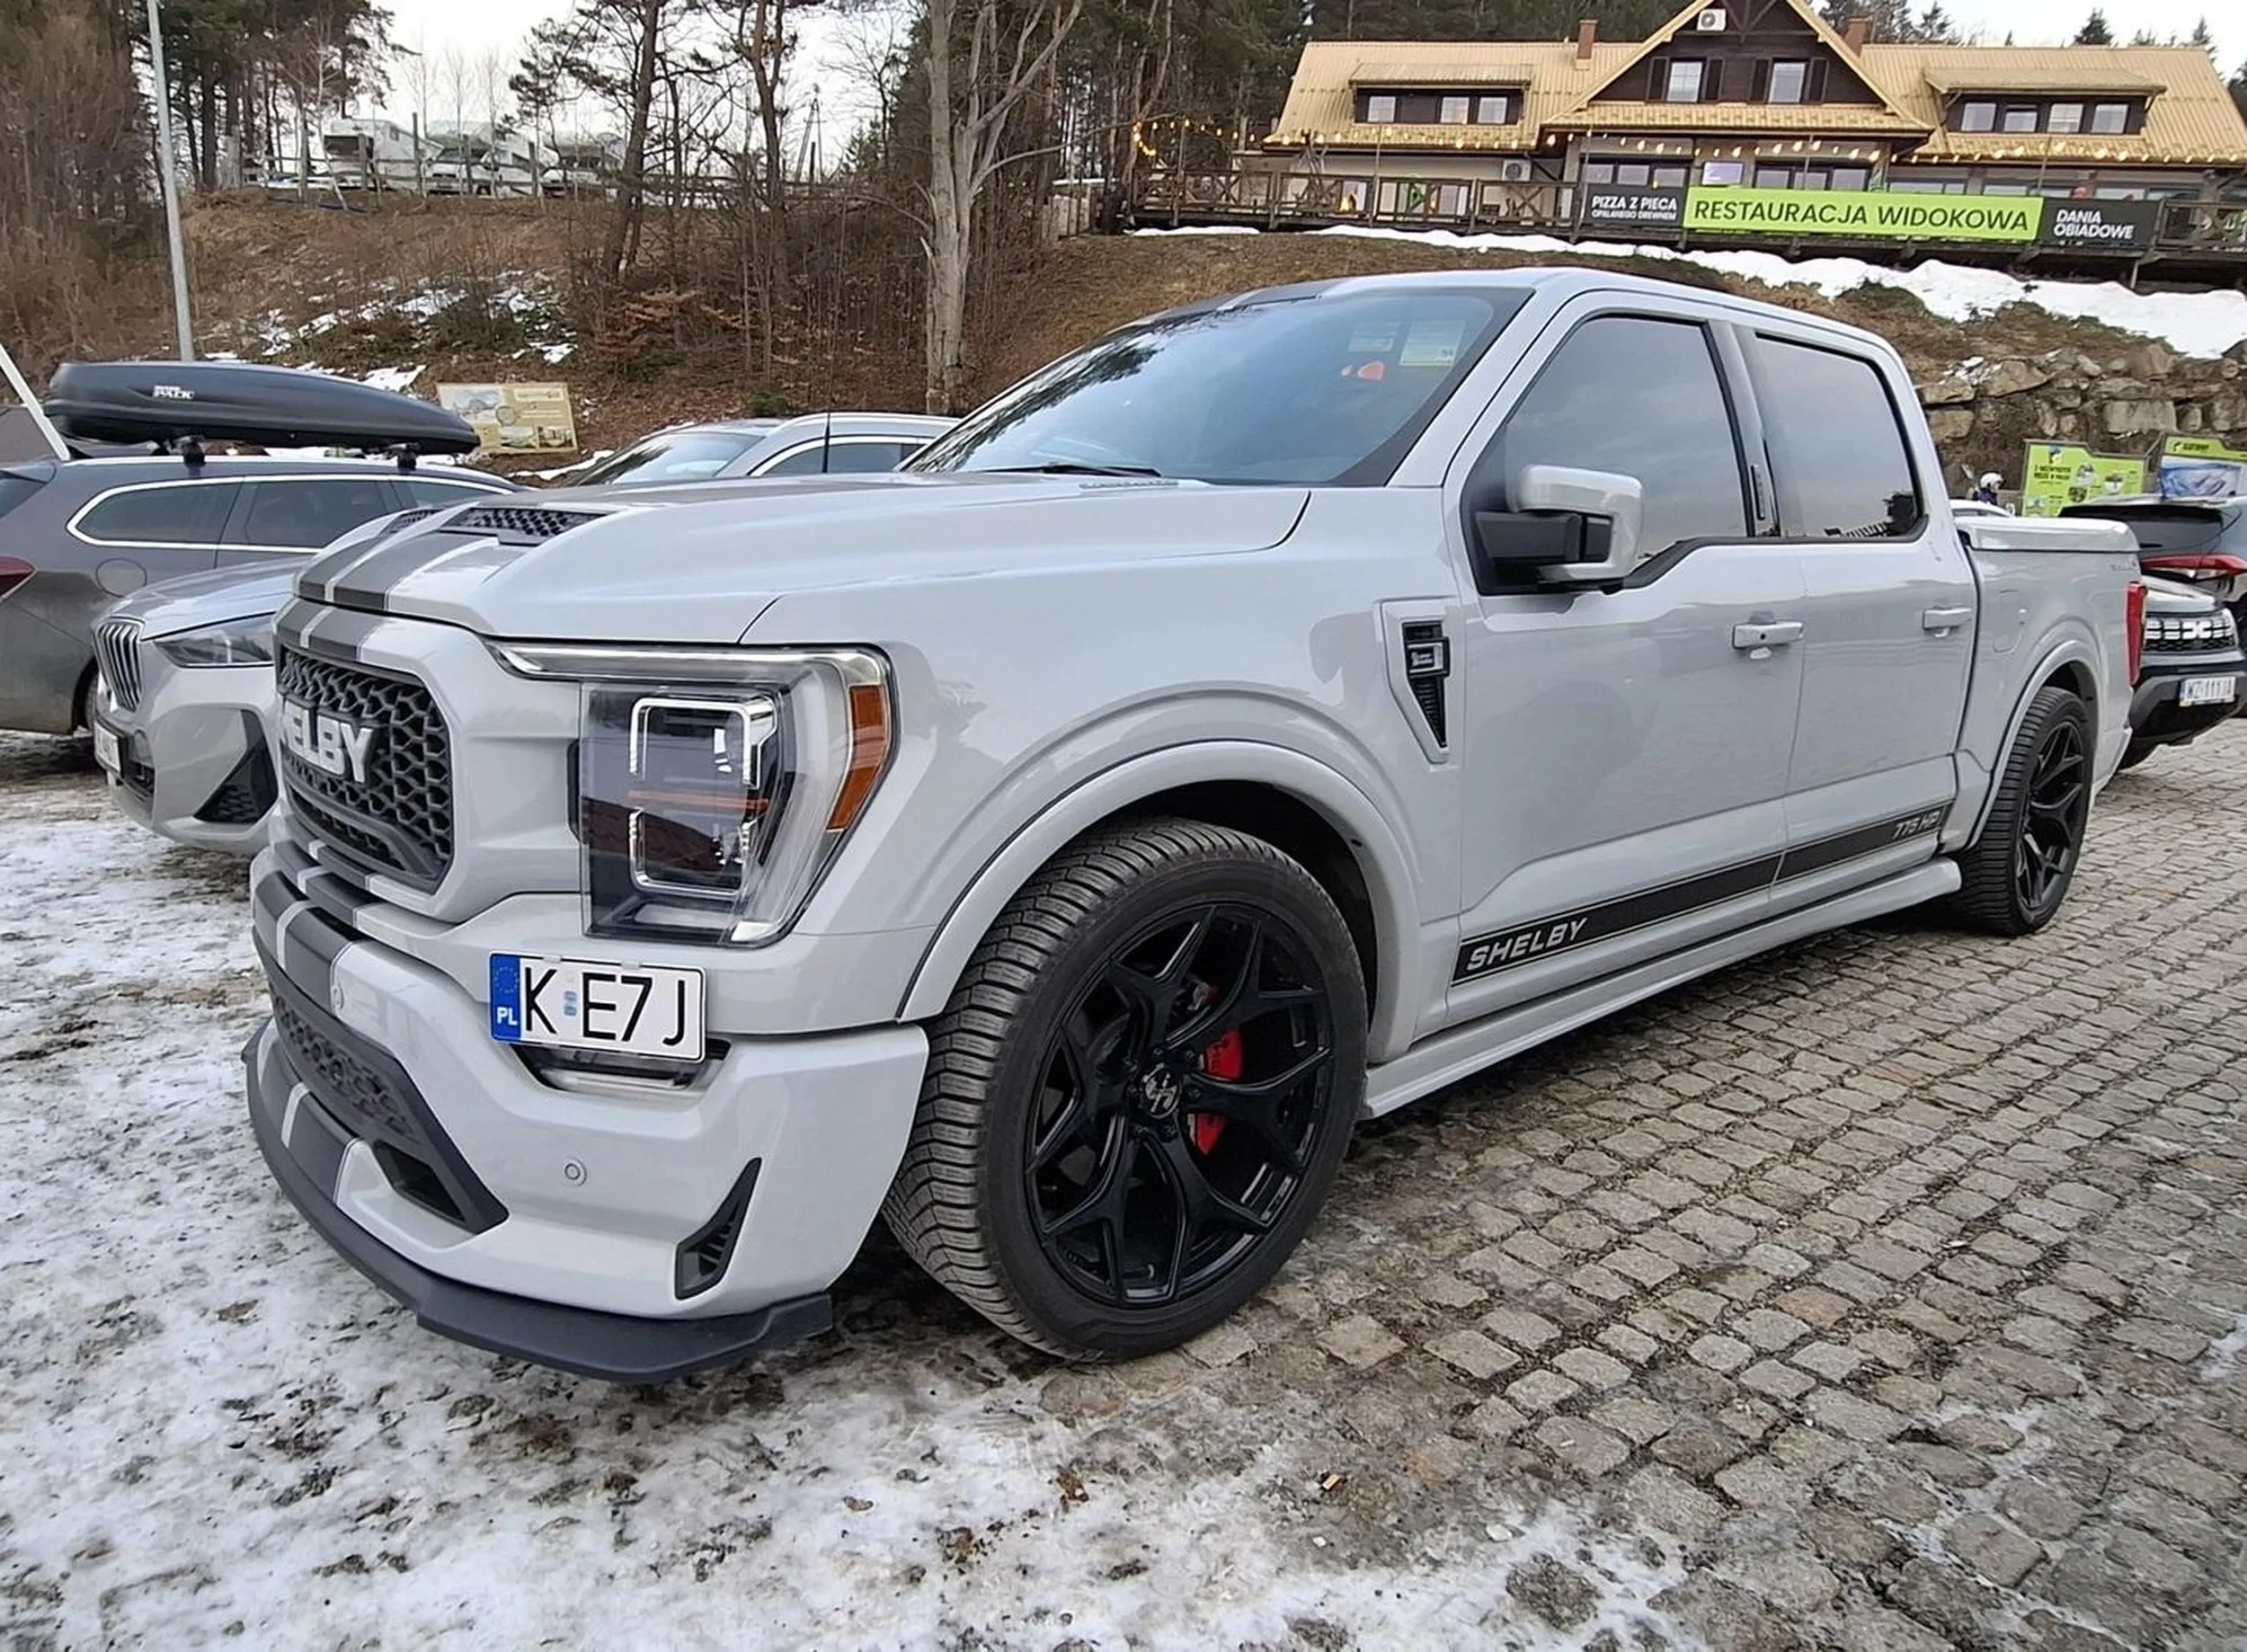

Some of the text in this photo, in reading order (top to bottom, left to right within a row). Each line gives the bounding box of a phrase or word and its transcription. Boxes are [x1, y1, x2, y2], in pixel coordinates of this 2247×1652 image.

[1592, 195, 1677, 210] PIZZA Z PIECA
[1694, 200, 2029, 231] RESTAURACJA WIDOKOWA
[2056, 209, 2101, 224] DANIA
[2053, 223, 2135, 239] OBIADOWE
[280, 699, 373, 783] ELBY
[1918, 811, 1941, 830] HP
[1466, 917, 1587, 971] SHELBY
[496, 1006, 519, 1026] PL
[525, 966, 686, 1046] K E7J
